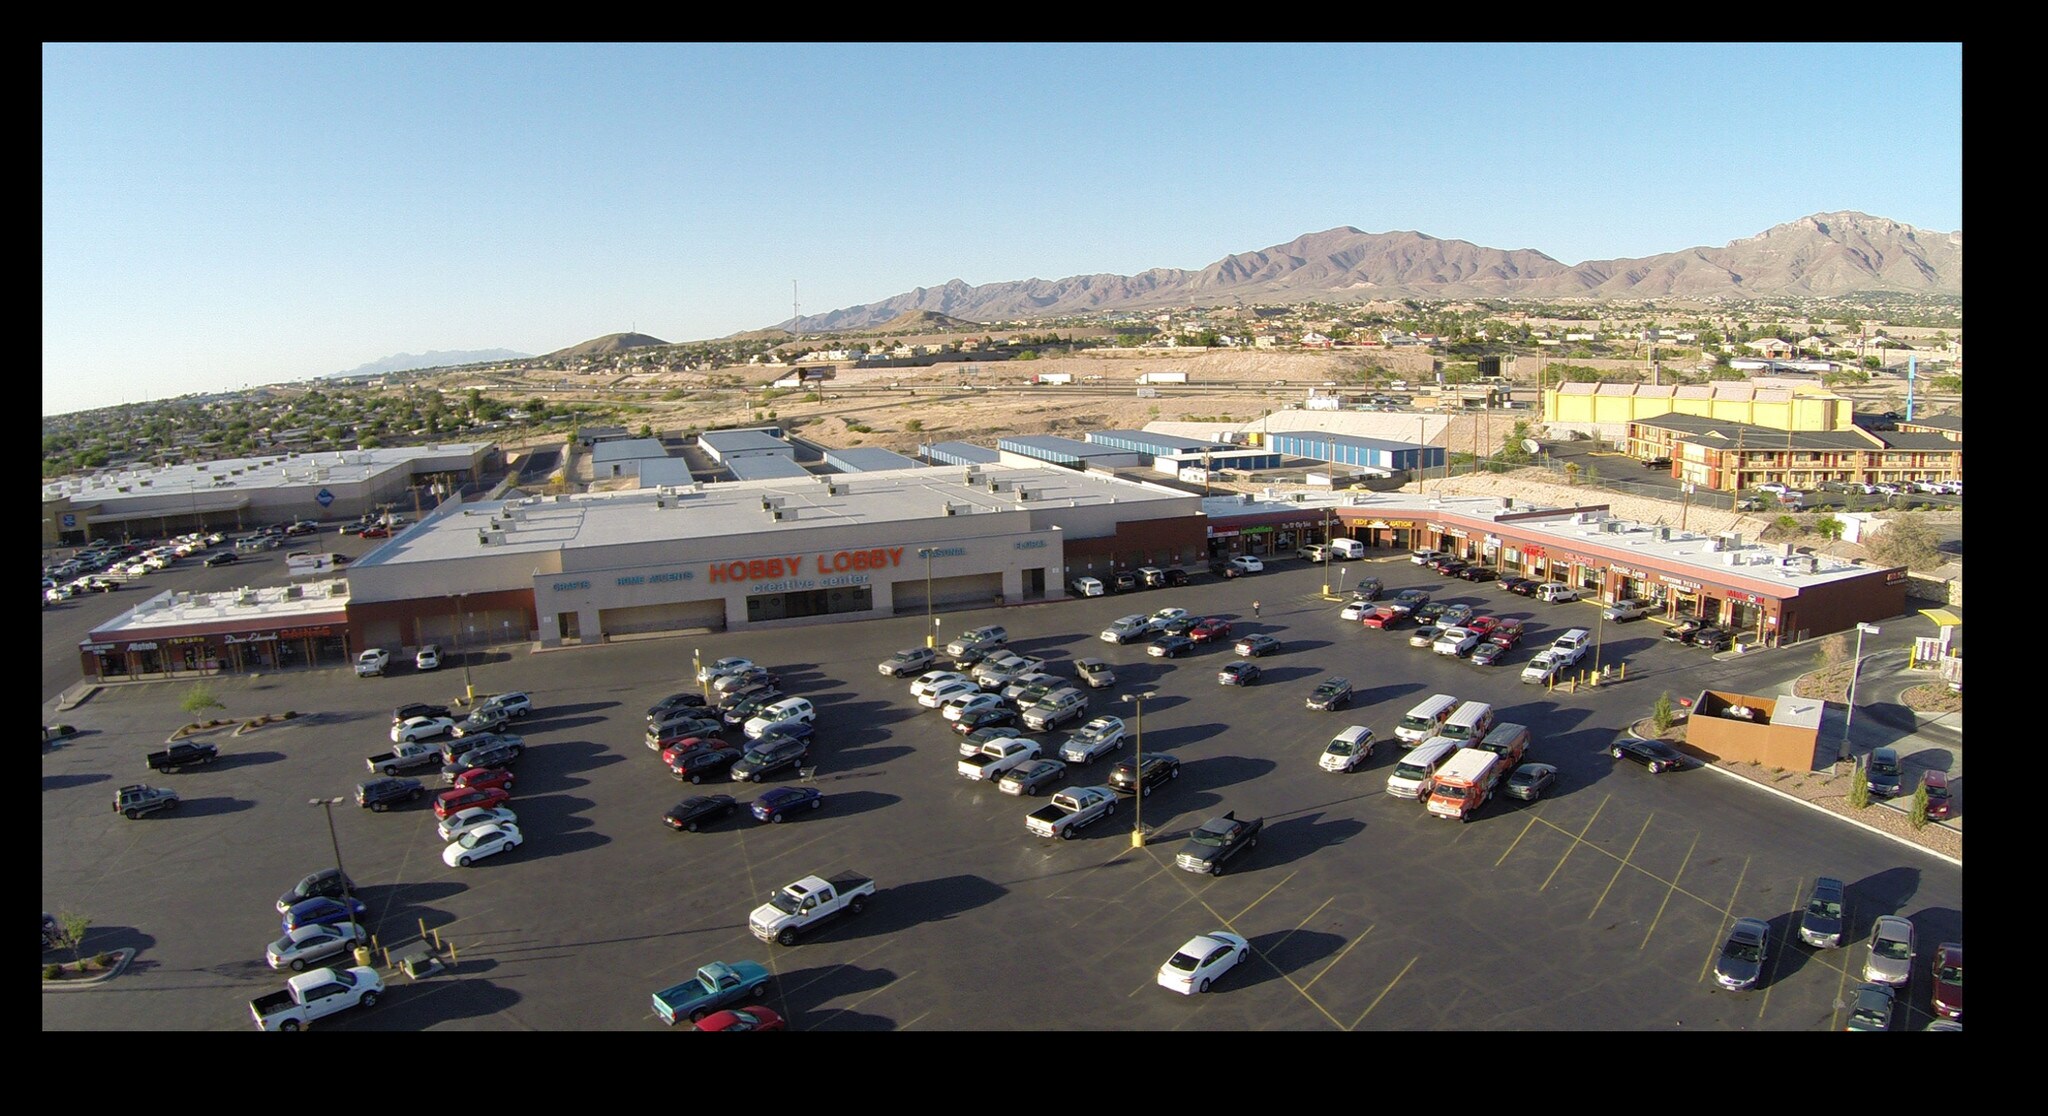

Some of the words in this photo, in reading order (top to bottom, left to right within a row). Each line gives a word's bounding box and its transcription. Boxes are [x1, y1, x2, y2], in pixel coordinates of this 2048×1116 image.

[919, 547, 967, 559] SASONAL
[709, 555, 802, 584] HOBBY
[817, 545, 904, 575] LOBBY
[751, 579, 815, 594] creative
[820, 574, 869, 588] center
[280, 625, 331, 640] PAINTS
